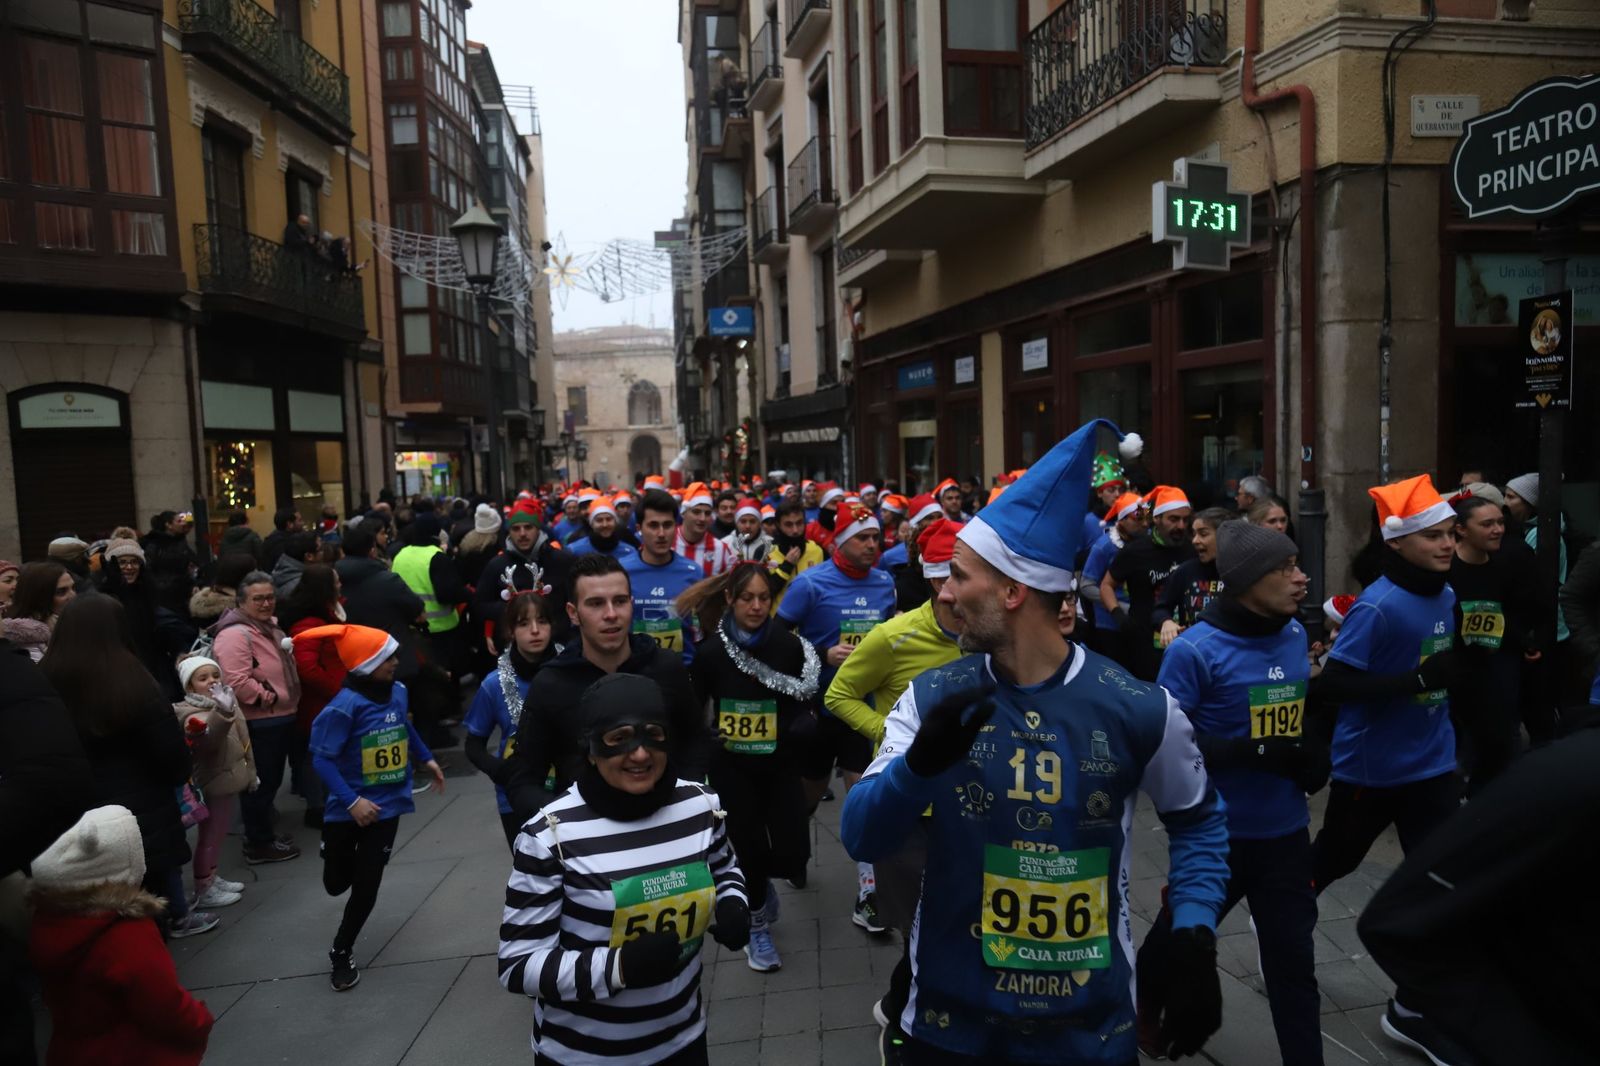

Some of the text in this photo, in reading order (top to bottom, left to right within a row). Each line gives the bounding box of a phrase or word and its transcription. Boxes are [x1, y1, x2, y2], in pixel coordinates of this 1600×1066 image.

[1435, 101, 1464, 109] CALLE
[1441, 112, 1453, 120] DE
[1492, 102, 1597, 156] TEATRO
[1478, 143, 1599, 198] PRINCIPA
[1173, 199, 1237, 231] 17:31
[1499, 265, 1545, 278] Un aliad
[1591, 267, 1600, 278] s
[1526, 283, 1542, 295] de
[650, 587, 665, 597] 46
[855, 597, 868, 607] 46
[1433, 621, 1446, 635] 46
[1465, 614, 1496, 633] 196
[1267, 666, 1285, 680] 46
[384, 712, 397, 723] 46
[1256, 704, 1299, 736] 1192
[723, 715, 769, 738] 384
[1011, 732, 1057, 742] MORALEJO
[971, 743, 998, 753] GEL
[375, 745, 402, 769] 68
[1006, 746, 1062, 804] 19
[1019, 864, 1078, 876] CAJA RURAL
[643, 879, 689, 896] CAJA RURAL
[625, 901, 697, 939] 561
[991, 888, 1091, 940] 956
[1017, 945, 1104, 962] CAJA RURAL
[994, 971, 1073, 997] ZAMORA
